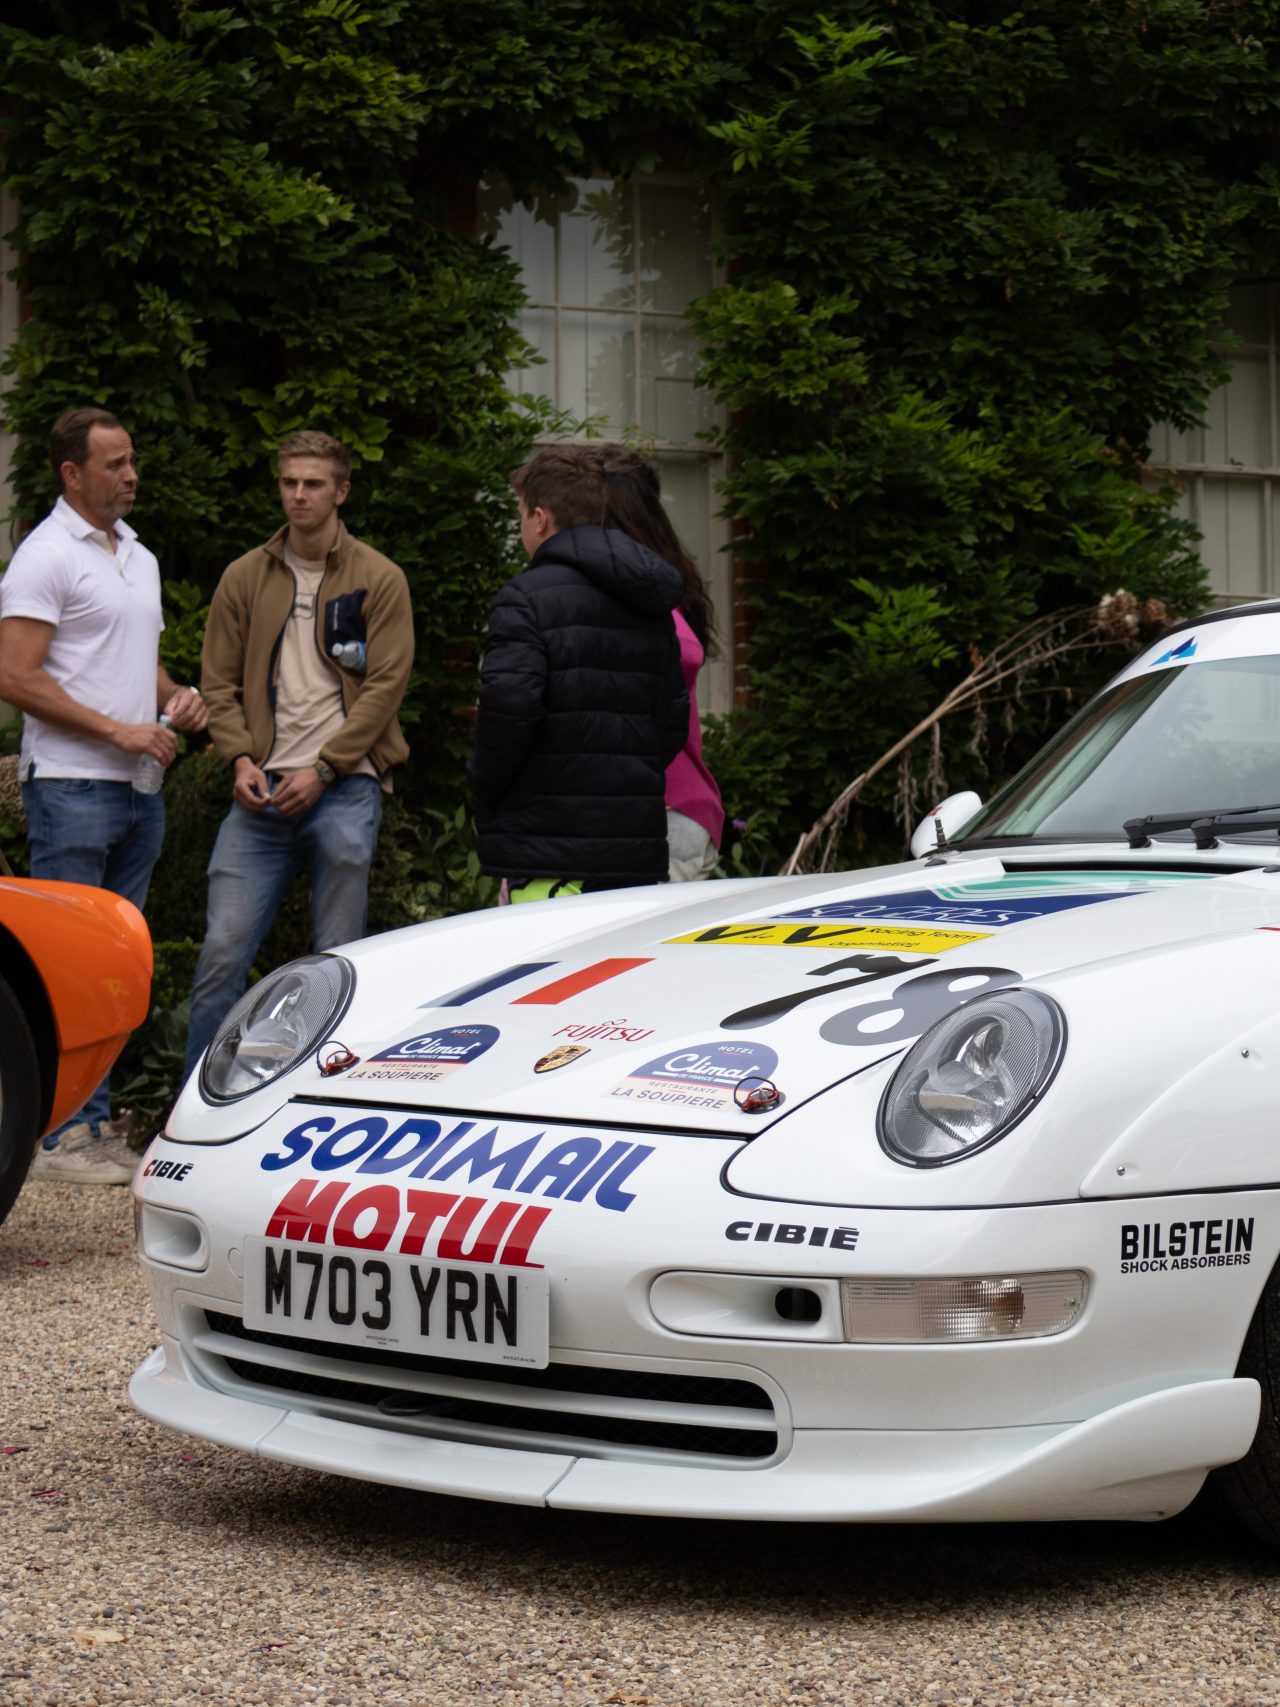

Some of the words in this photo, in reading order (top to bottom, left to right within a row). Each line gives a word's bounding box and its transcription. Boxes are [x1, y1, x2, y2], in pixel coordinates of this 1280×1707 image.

[694, 926, 777, 942] V
[782, 926, 867, 944] V
[719, 953, 1024, 1046] 78
[552, 1024, 657, 1042] FUJITSU
[399, 1037, 482, 1055] Climat
[718, 1045, 754, 1055] HOTEL
[347, 1071, 368, 1080] LA
[368, 1071, 444, 1081] SOUPIERE
[664, 1053, 760, 1079] Climat
[648, 1081, 719, 1094] RESTAURANTE
[688, 1074, 714, 1082] FRANCE
[611, 1087, 631, 1097] LA
[636, 1089, 728, 1109] SOUPIERE
[260, 1116, 656, 1213] SODIMAIL
[264, 1178, 553, 1269] MOTUL
[1121, 1217, 1255, 1260] BILSTEIN
[1120, 1259, 1169, 1274] SHOCK
[1170, 1253, 1251, 1271] ABSORBERS
[265, 1246, 392, 1332] M703
[410, 1264, 518, 1348] YRN
